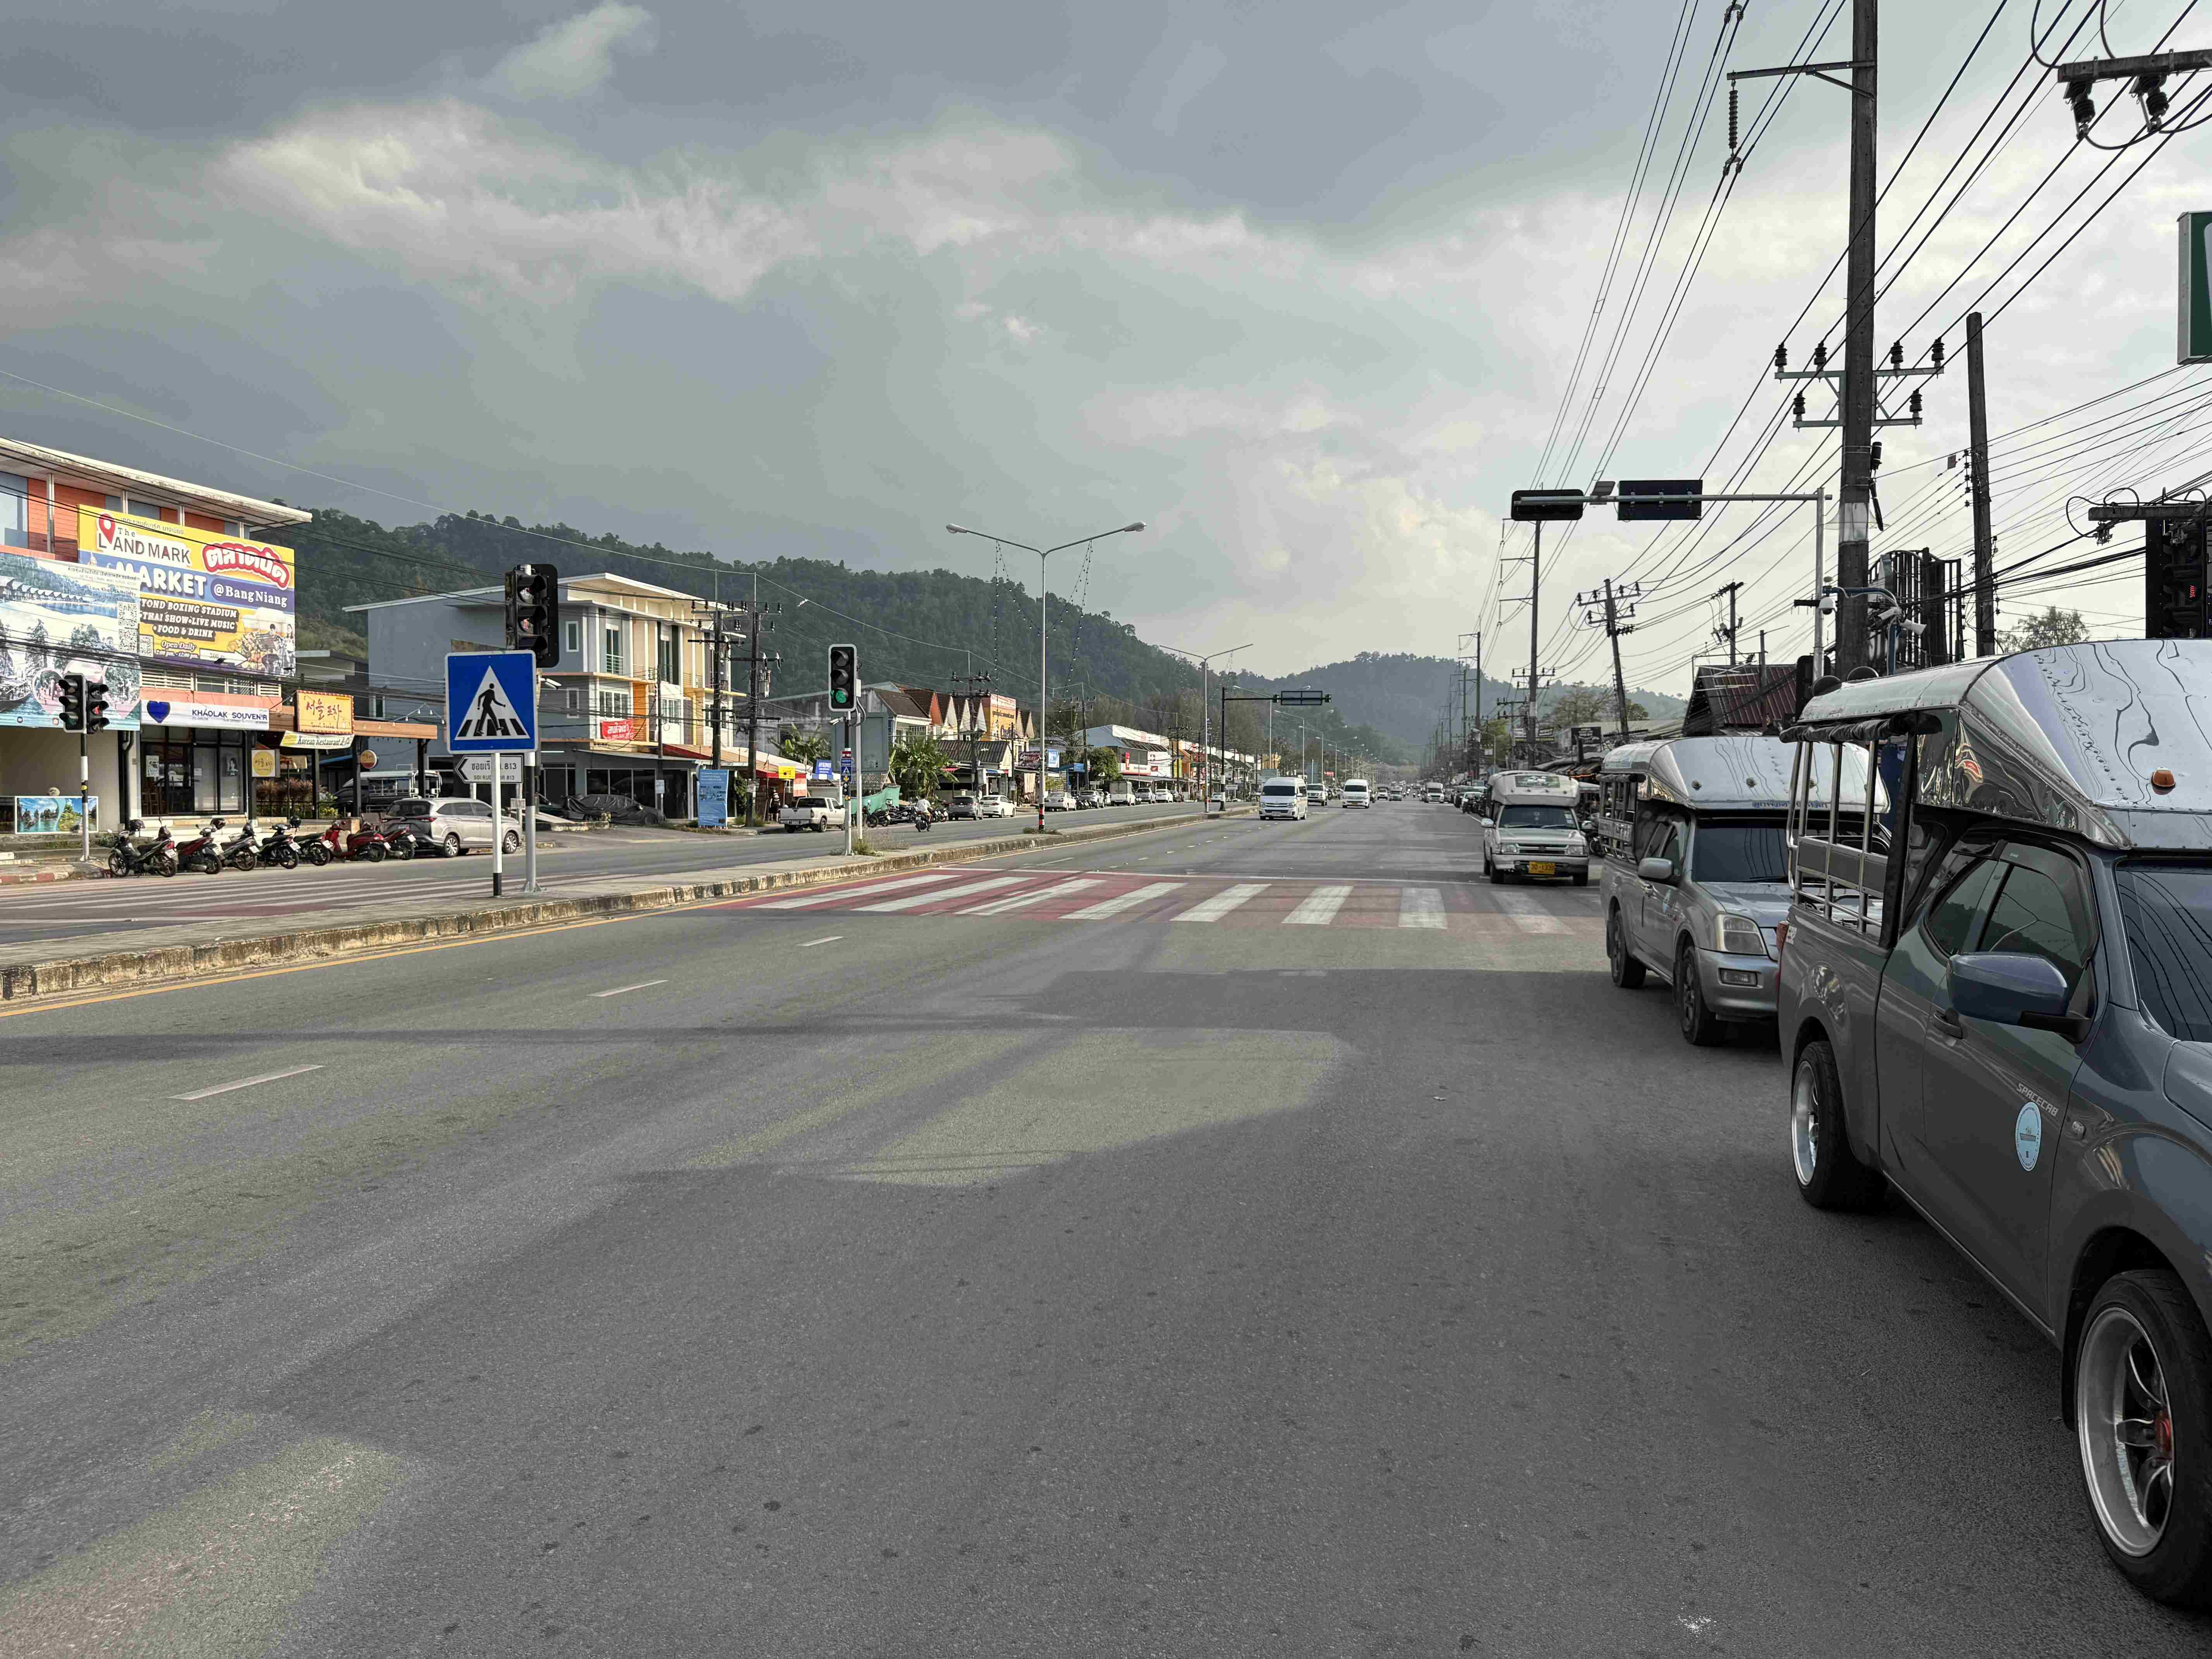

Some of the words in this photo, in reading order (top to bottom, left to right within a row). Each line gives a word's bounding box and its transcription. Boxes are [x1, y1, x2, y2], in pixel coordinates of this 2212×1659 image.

[117, 527, 136, 537] The
[98, 533, 145, 555] LAND
[148, 543, 191, 564] MARK
[206, 547, 287, 583] ตลาดนัด
[167, 601, 200, 613] BOXING
[201, 606, 237, 618] STADIUM
[210, 620, 235, 629] MUSIC
[188, 628, 213, 638] DRINK
[161, 640, 179, 649] Open
[179, 642, 196, 651] Daily
[192, 709, 228, 718] KHAOLAK
[232, 712, 267, 720] SOUVENIR
[297, 736, 316, 745] Korean
[316, 735, 340, 745] Restaurant
[2016, 1083, 2059, 1117] SPACECAB
